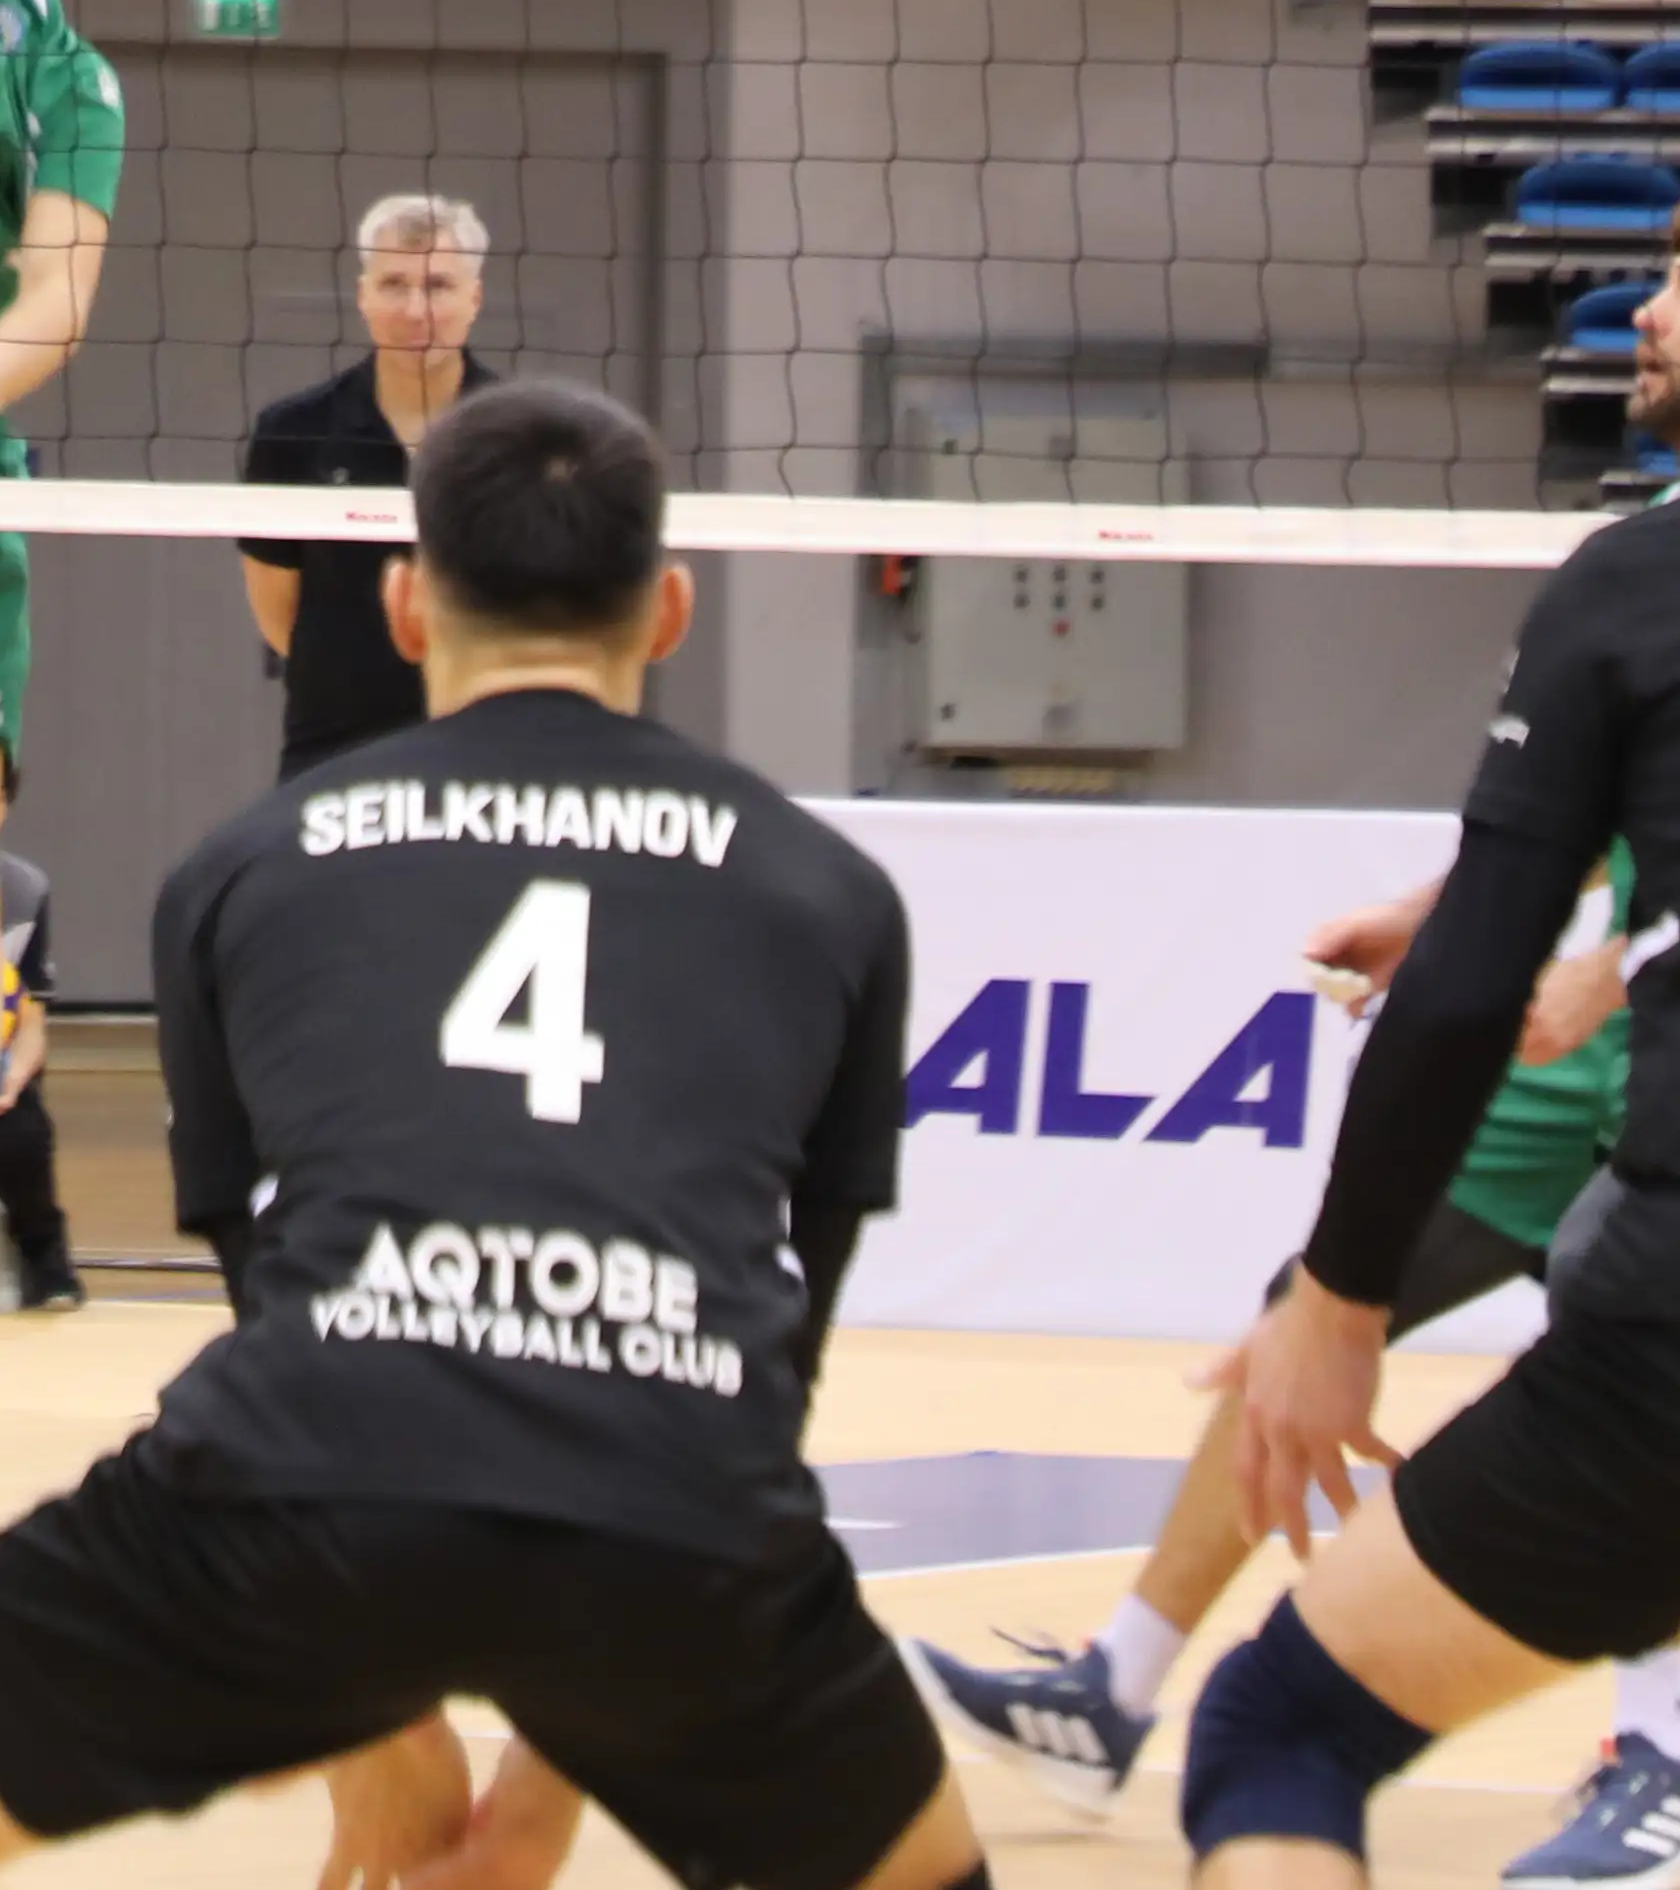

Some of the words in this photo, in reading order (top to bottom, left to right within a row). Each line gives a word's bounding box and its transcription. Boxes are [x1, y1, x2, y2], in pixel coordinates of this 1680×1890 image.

[299, 778, 738, 868] SEILKHANOV
[438, 876, 605, 1125] 4
[352, 1220, 699, 1335] AQTOBE
[310, 1291, 612, 1373] VOLLEYBALL
[618, 1329, 743, 1398] CLUB
